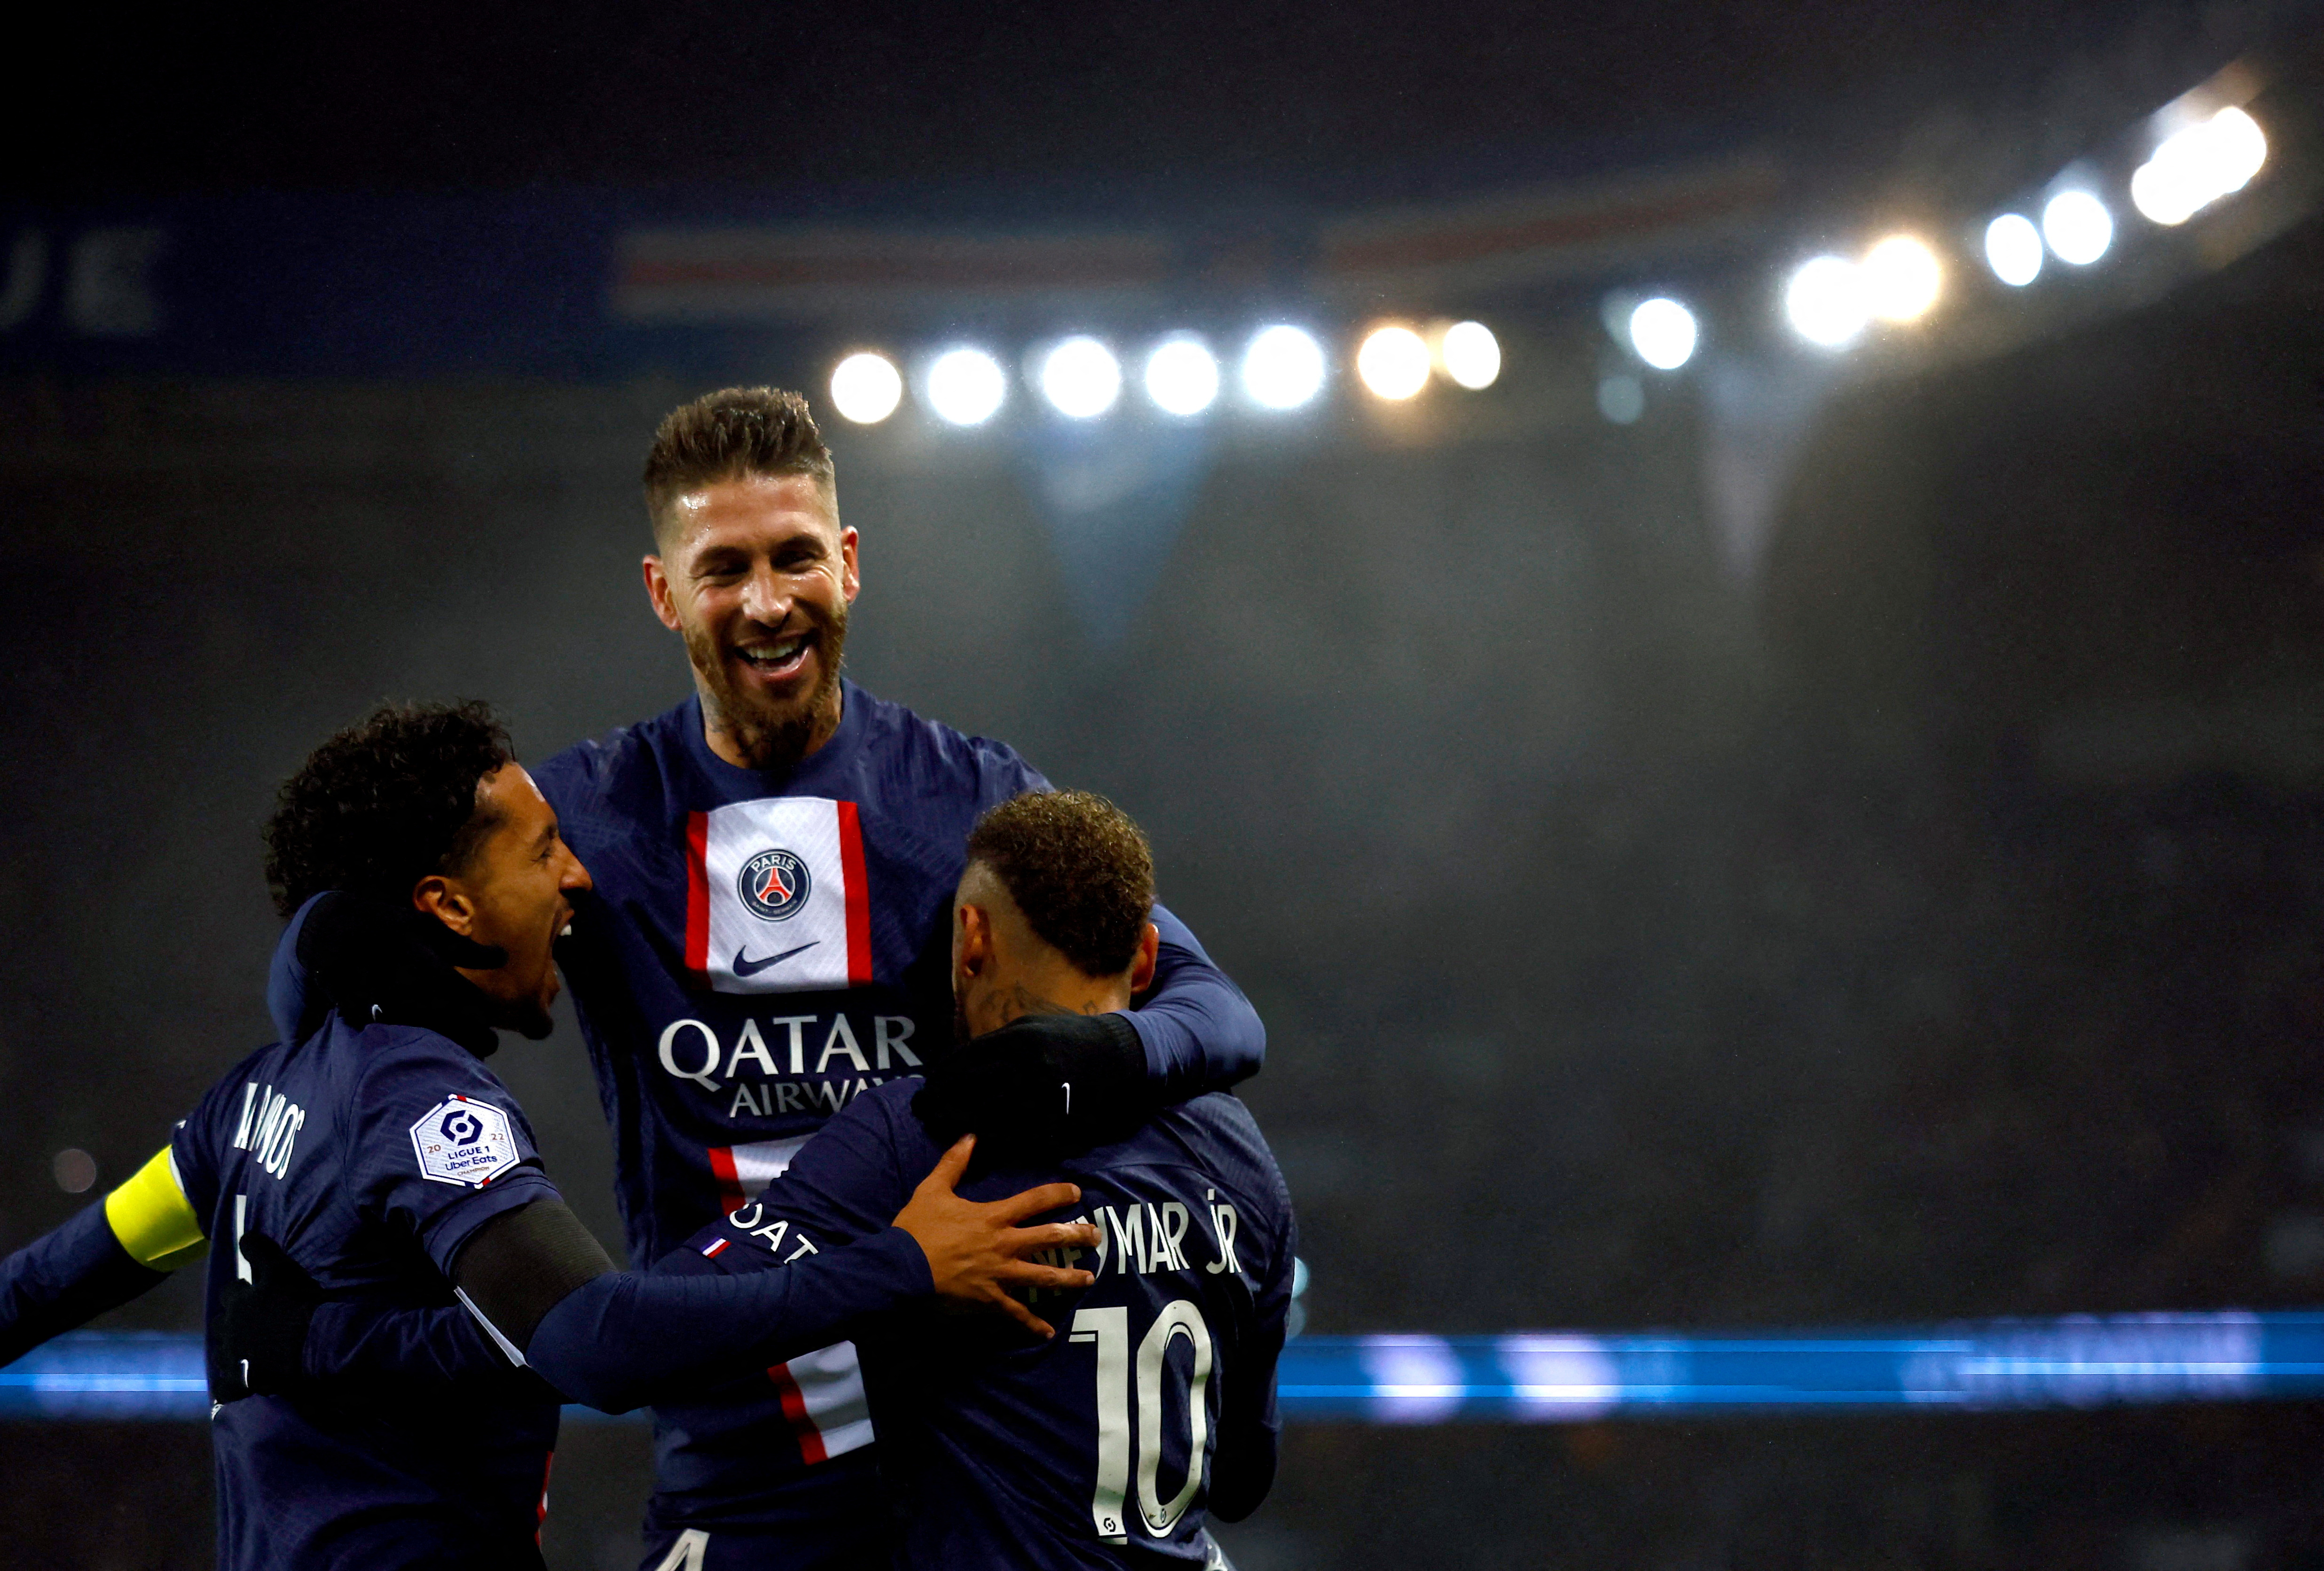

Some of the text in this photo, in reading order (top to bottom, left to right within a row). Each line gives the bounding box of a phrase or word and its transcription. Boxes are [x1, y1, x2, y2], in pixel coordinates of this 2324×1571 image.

[751, 855, 796, 872] PARIS
[658, 1012, 924, 1092] QATAR
[729, 1074, 924, 1118] AIRW
[427, 1145, 441, 1153] 20
[448, 1147, 482, 1159] LIGUE
[445, 1156, 497, 1170] Uber Eats
[457, 1167, 489, 1175] CHAMPION
[1069, 1300, 1212, 1545] 10
